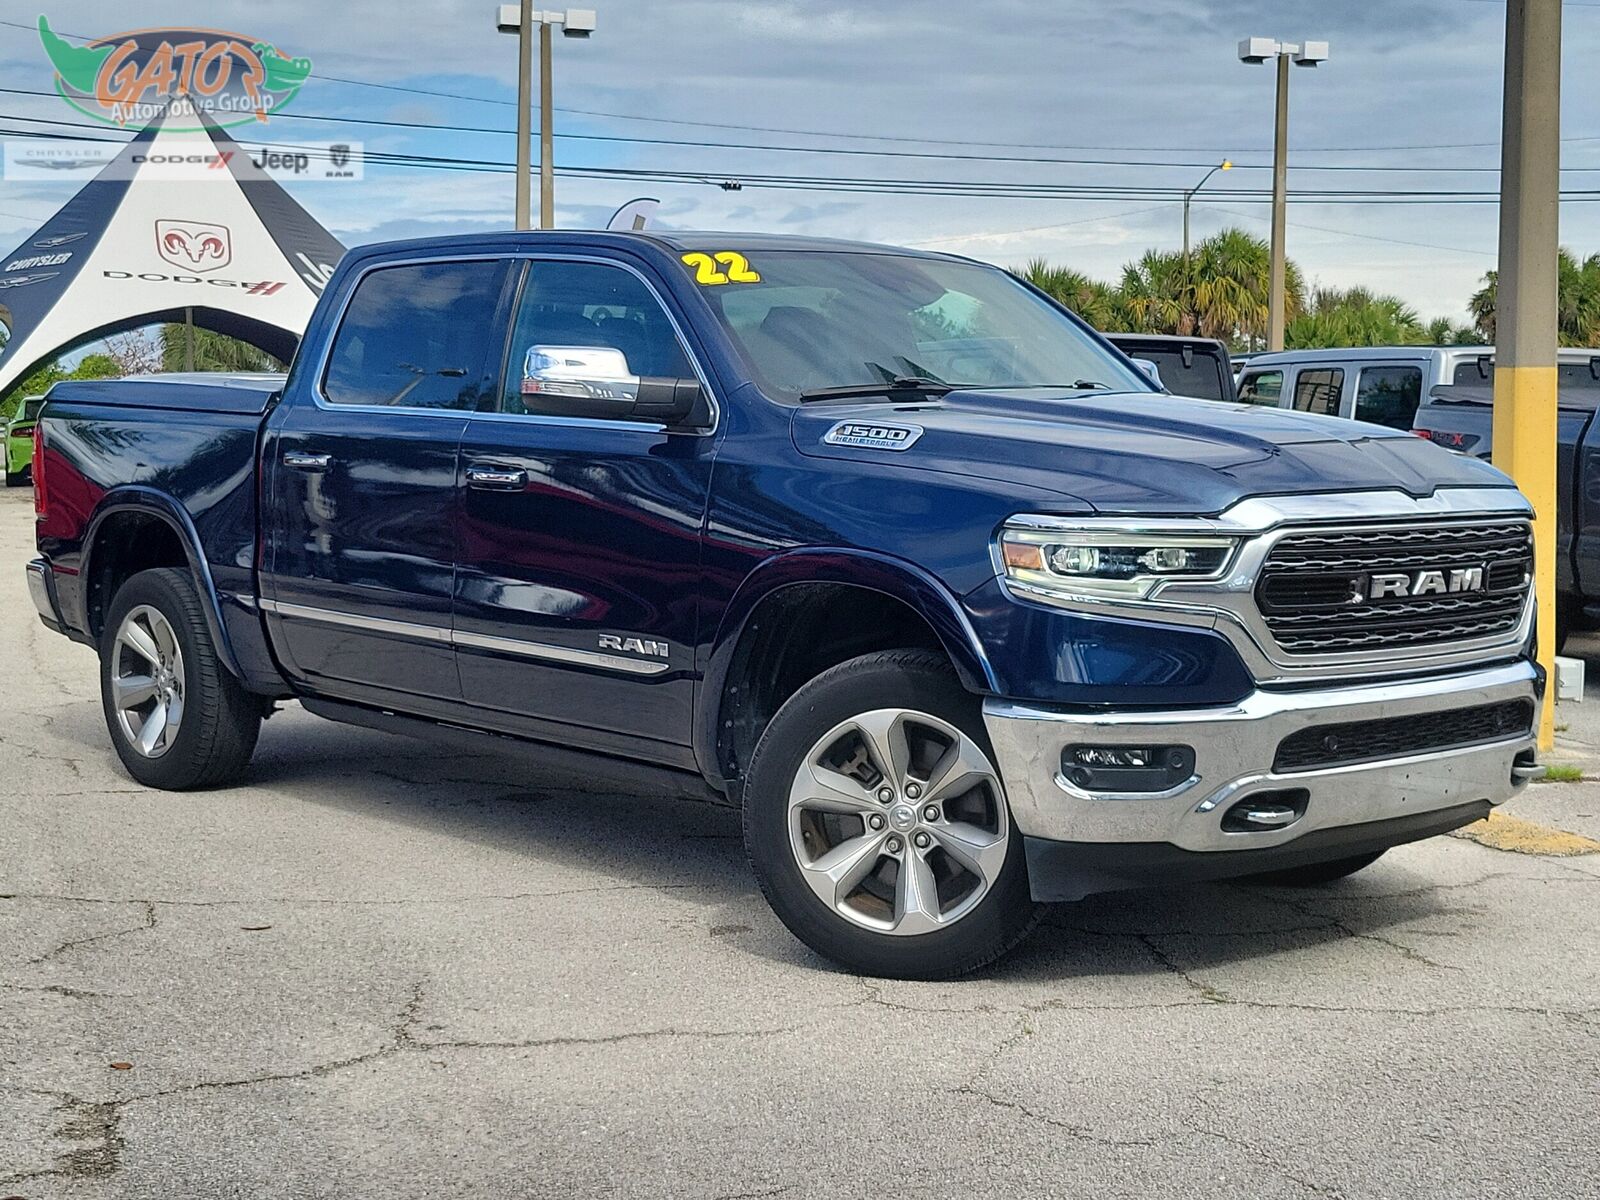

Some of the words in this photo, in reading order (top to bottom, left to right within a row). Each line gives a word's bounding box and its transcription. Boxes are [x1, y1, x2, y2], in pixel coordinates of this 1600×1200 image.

[5, 252, 73, 272] CHRYSLER
[681, 251, 761, 285] 22
[103, 270, 266, 289] DODGE
[842, 425, 908, 441] 1500
[1370, 568, 1483, 599] RAM
[598, 633, 669, 658] RAM
